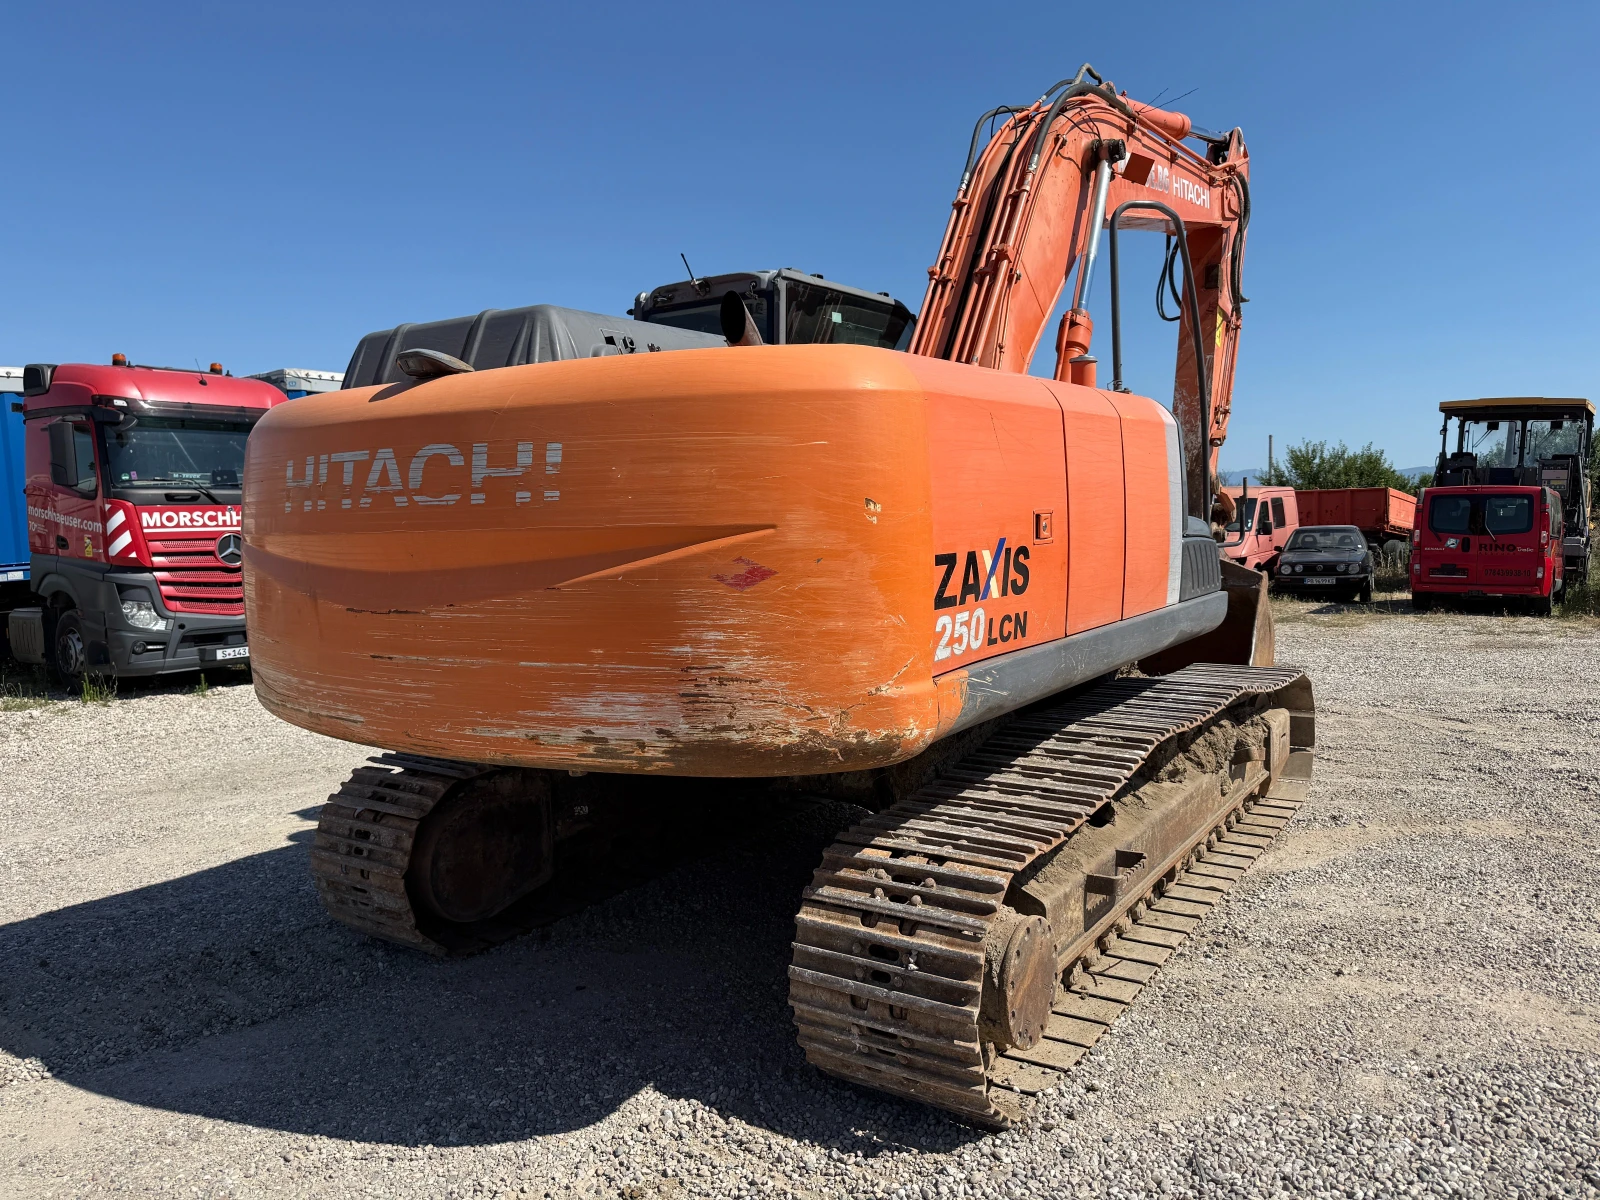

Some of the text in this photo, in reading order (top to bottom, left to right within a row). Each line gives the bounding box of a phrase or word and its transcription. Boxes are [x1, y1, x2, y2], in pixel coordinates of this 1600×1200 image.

[1173, 174, 1210, 209] HITACHI
[28, 505, 102, 533] morschhaeuser.com
[1479, 543, 1516, 552] RINO
[934, 537, 1030, 610] ZAXIS
